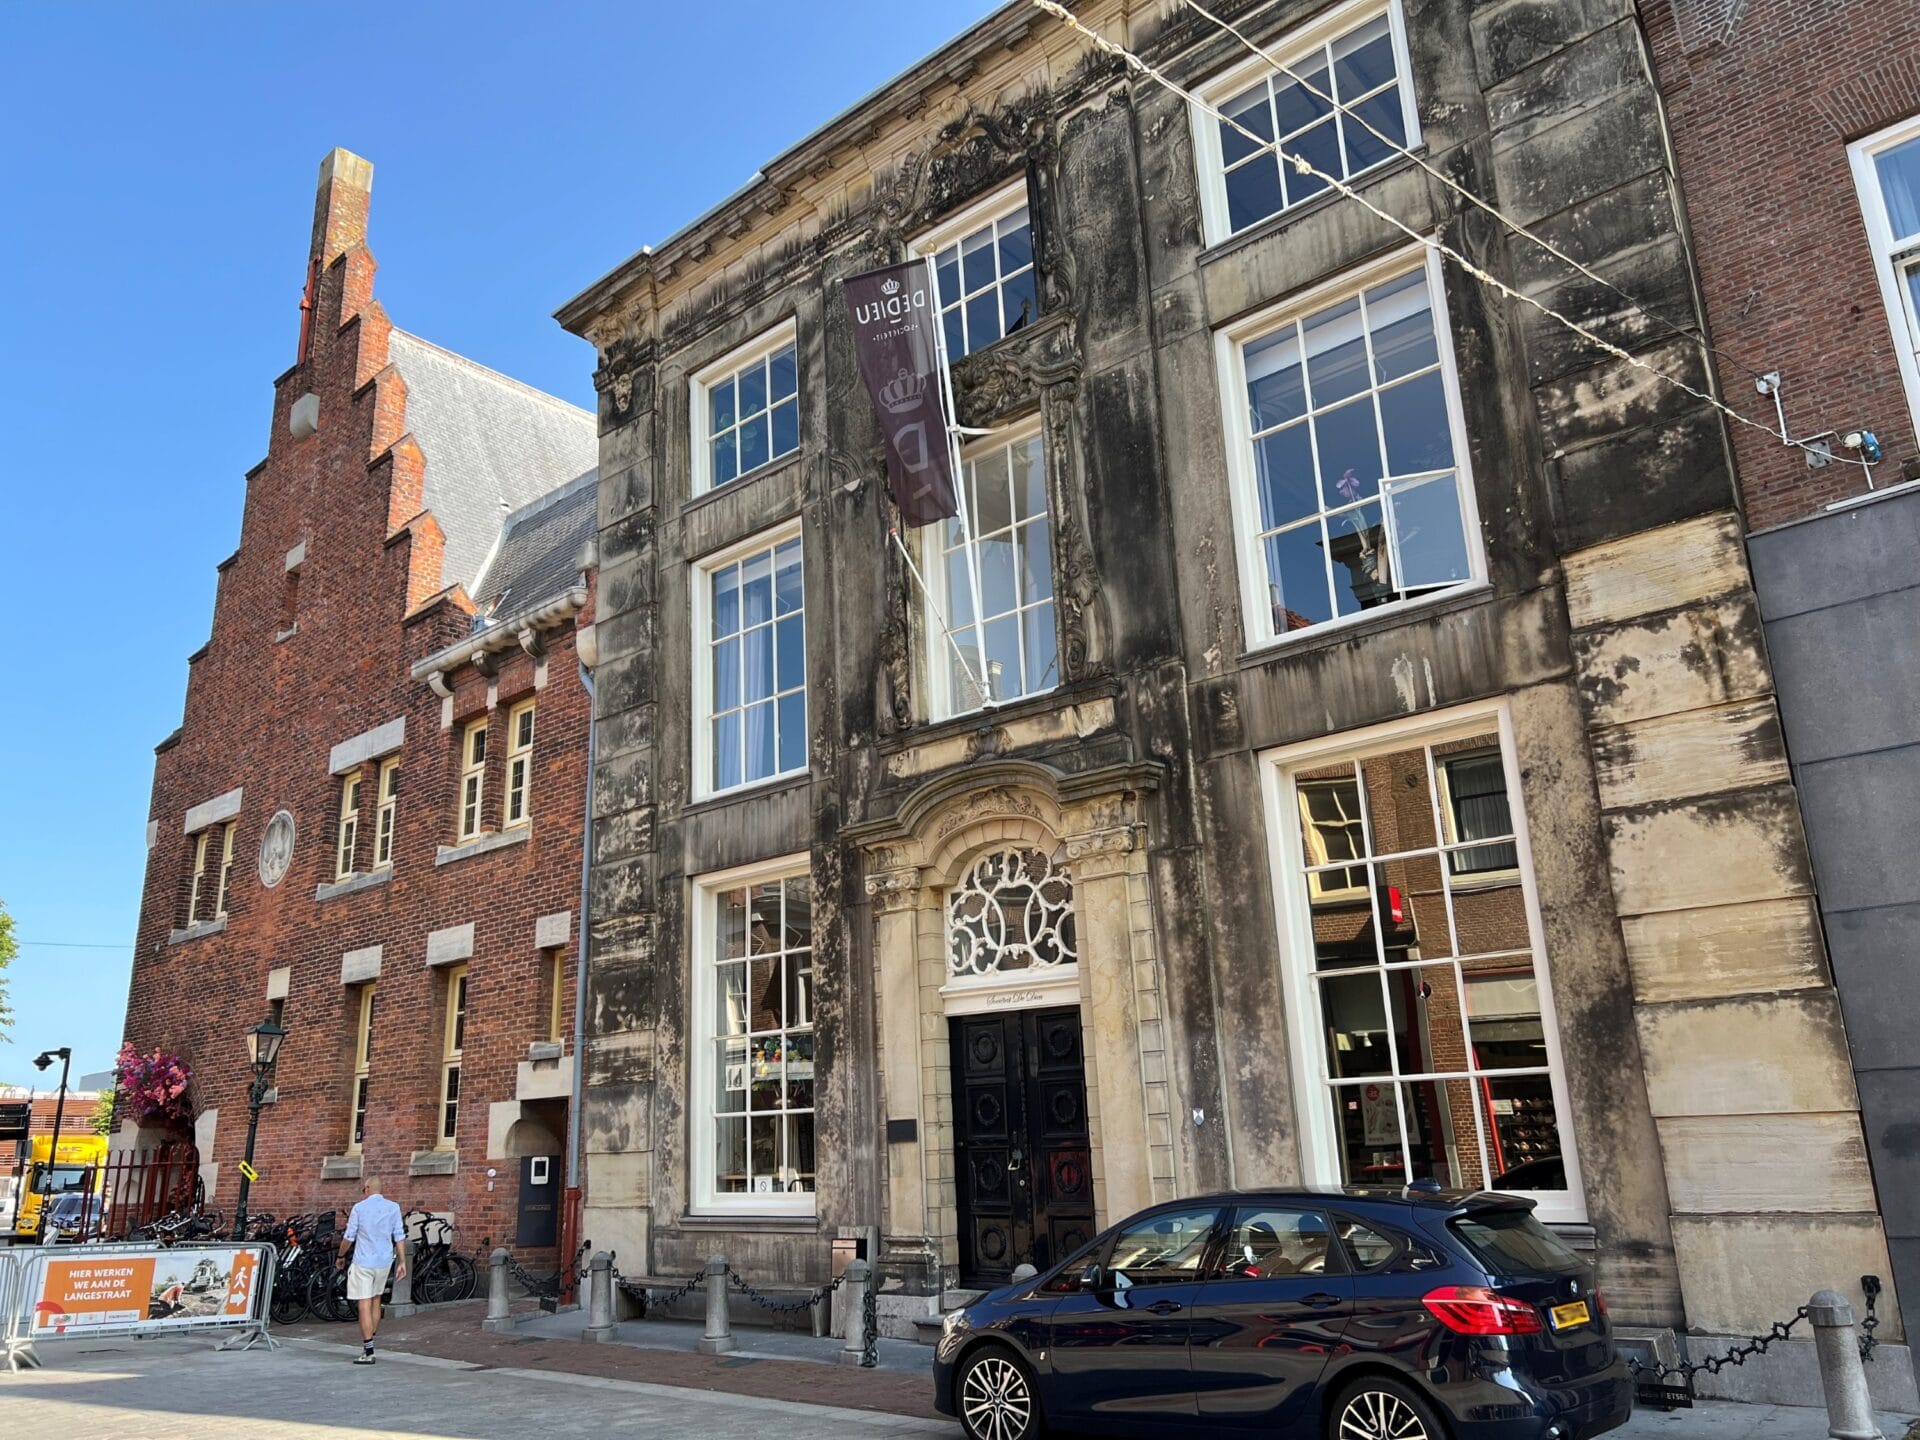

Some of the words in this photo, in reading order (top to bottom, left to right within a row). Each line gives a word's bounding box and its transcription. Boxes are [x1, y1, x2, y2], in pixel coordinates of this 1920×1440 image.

[69, 1269, 92, 1278] HIER
[94, 1267, 134, 1278] WERKEN
[74, 1281, 89, 1289] WE
[90, 1280, 111, 1288] AAN
[113, 1279, 126, 1288] DE
[64, 1289, 132, 1301] LANGESTRAAT
